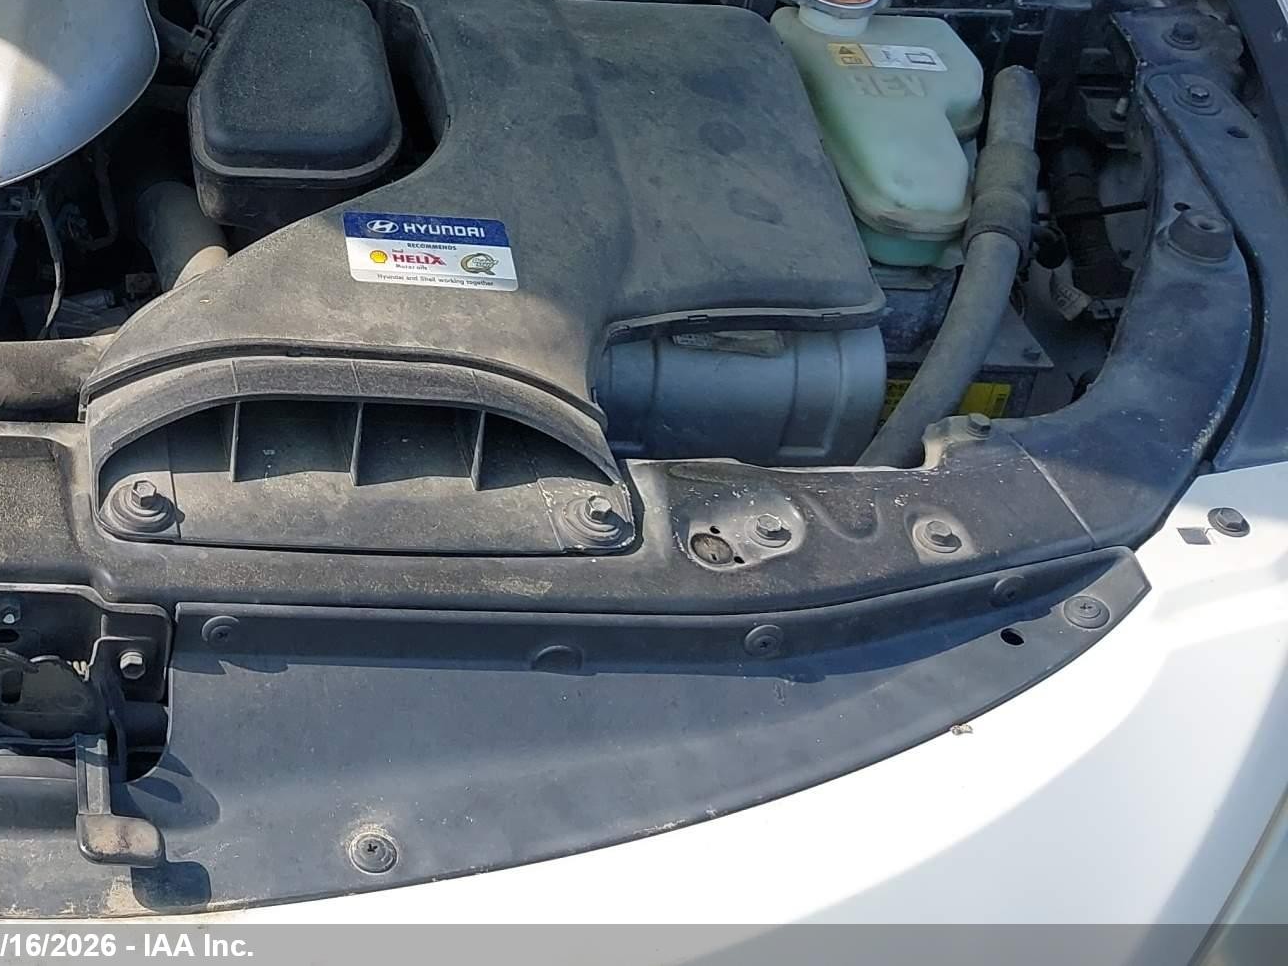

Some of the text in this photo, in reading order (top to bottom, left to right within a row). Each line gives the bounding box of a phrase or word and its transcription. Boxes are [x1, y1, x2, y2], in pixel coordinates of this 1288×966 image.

[403, 222, 485, 238] HYUNDAI
[407, 242, 457, 251] RECOMMENDS
[392, 252, 447, 266] HELIX
[438, 277, 465, 285] working
[466, 279, 494, 287] together
